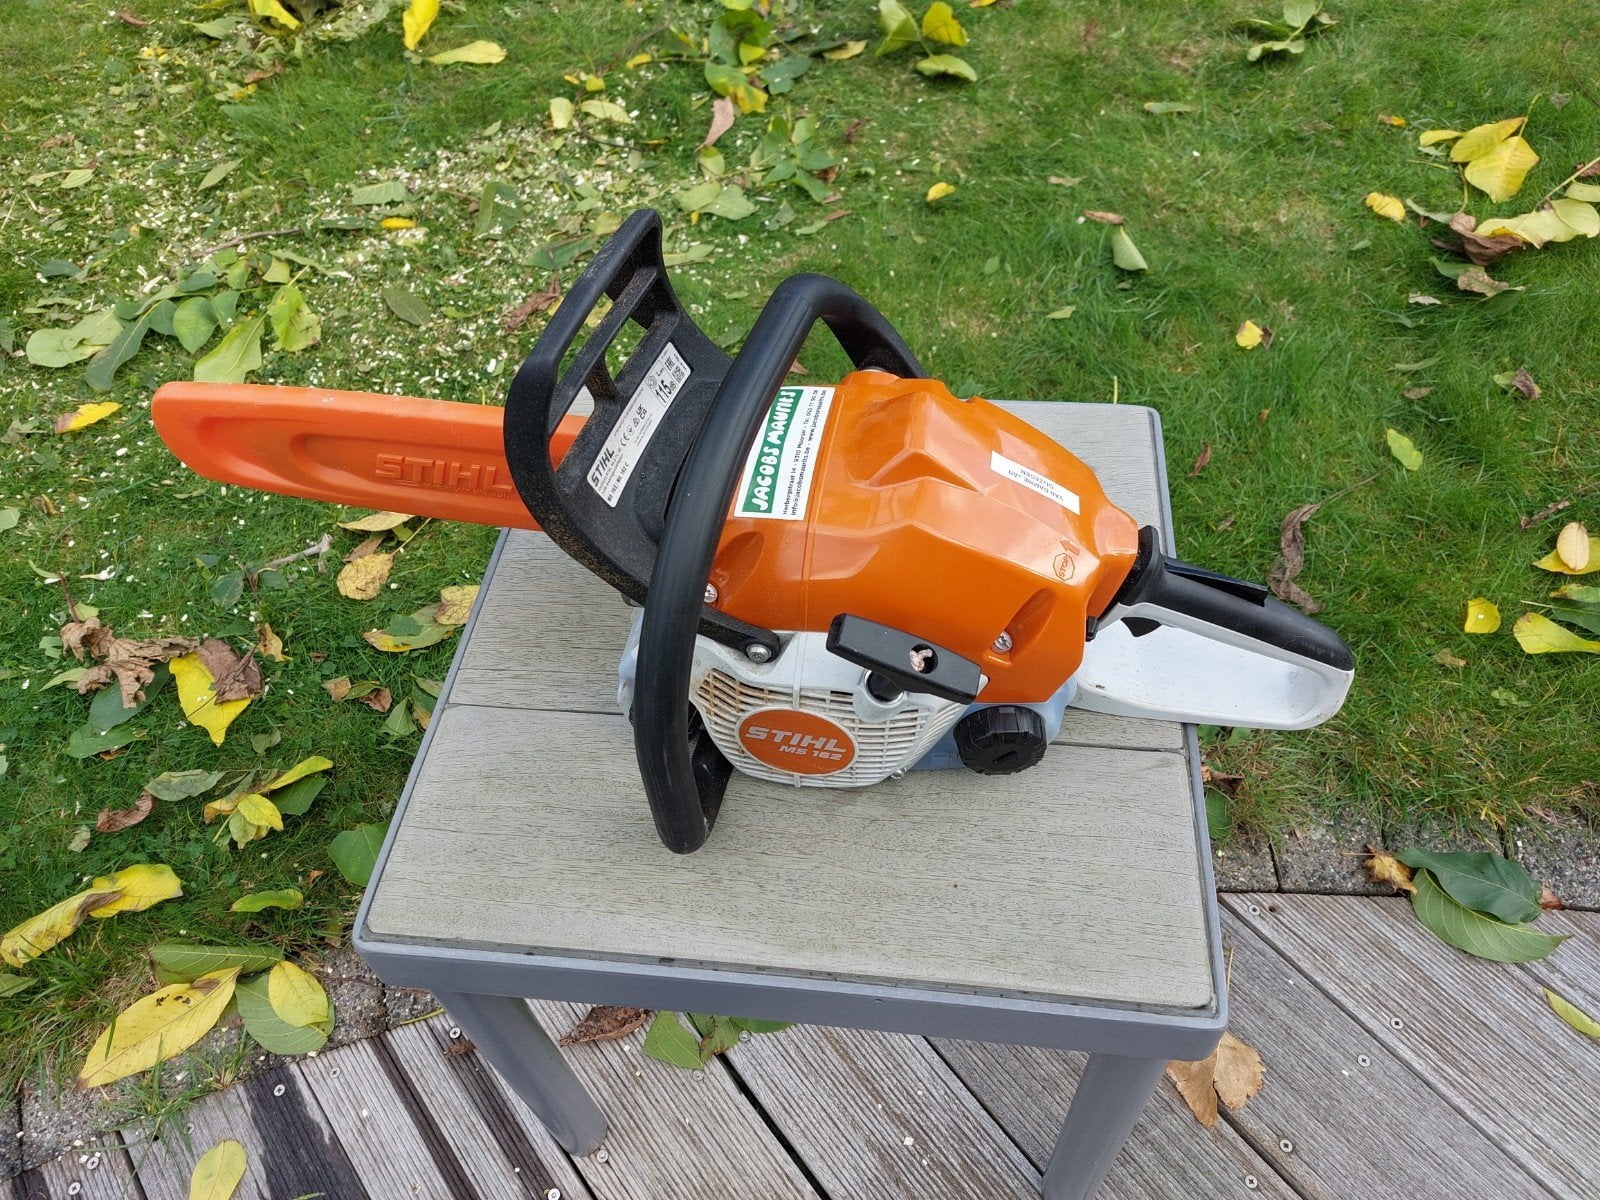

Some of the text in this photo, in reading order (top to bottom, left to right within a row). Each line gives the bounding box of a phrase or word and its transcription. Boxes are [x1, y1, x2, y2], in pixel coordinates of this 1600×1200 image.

[655, 379, 672, 403] 115
[374, 452, 515, 492] STIHL
[591, 448, 615, 487] STIHL
[751, 446, 780, 511] JACOBS
[1058, 555, 1070, 579] STOP
[745, 725, 847, 754] STIHL
[779, 745, 808, 756] MS
